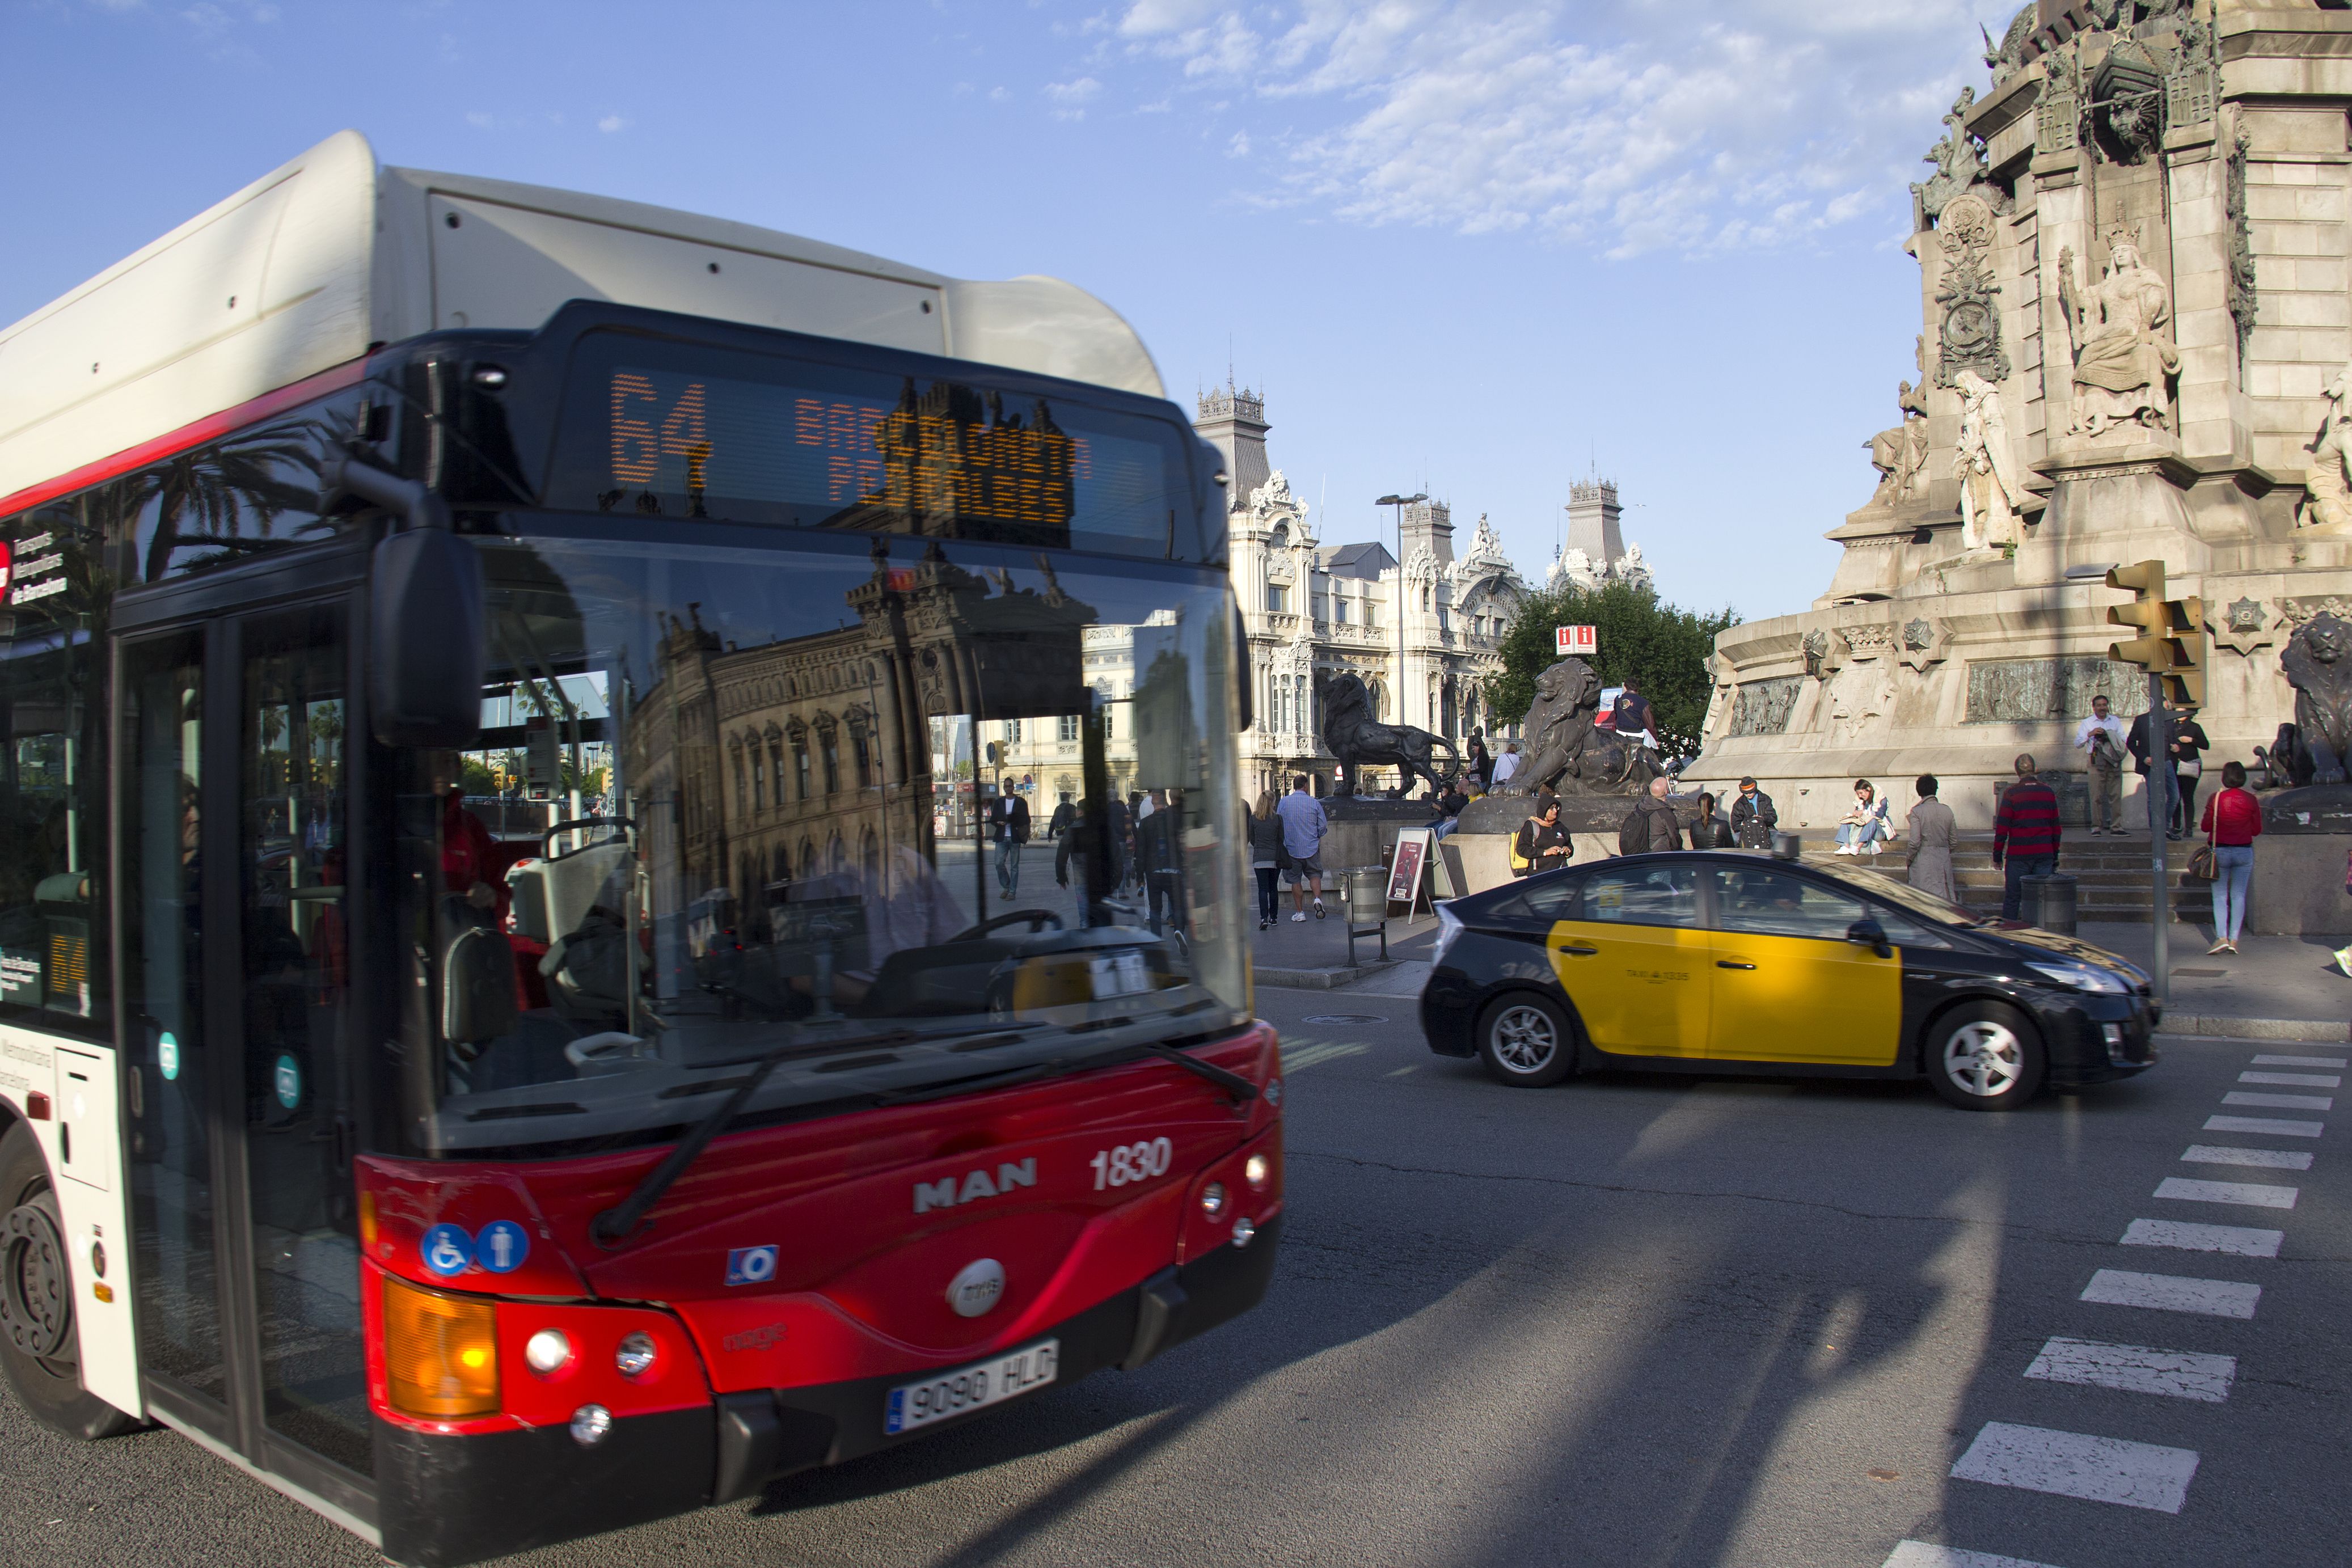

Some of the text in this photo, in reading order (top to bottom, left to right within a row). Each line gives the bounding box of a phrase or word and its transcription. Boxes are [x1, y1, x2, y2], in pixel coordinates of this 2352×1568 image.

[611, 373, 714, 489] 64
[795, 399, 1092, 479] BARCELONETA
[829, 456, 1066, 523] PEDRALBES
[11, 588, 23, 605] de
[23, 577, 67, 602] Barcelona
[912, 1157, 1037, 1215] MAN
[1090, 1136, 1173, 1191] 1830
[912, 1370, 989, 1419] 9090
